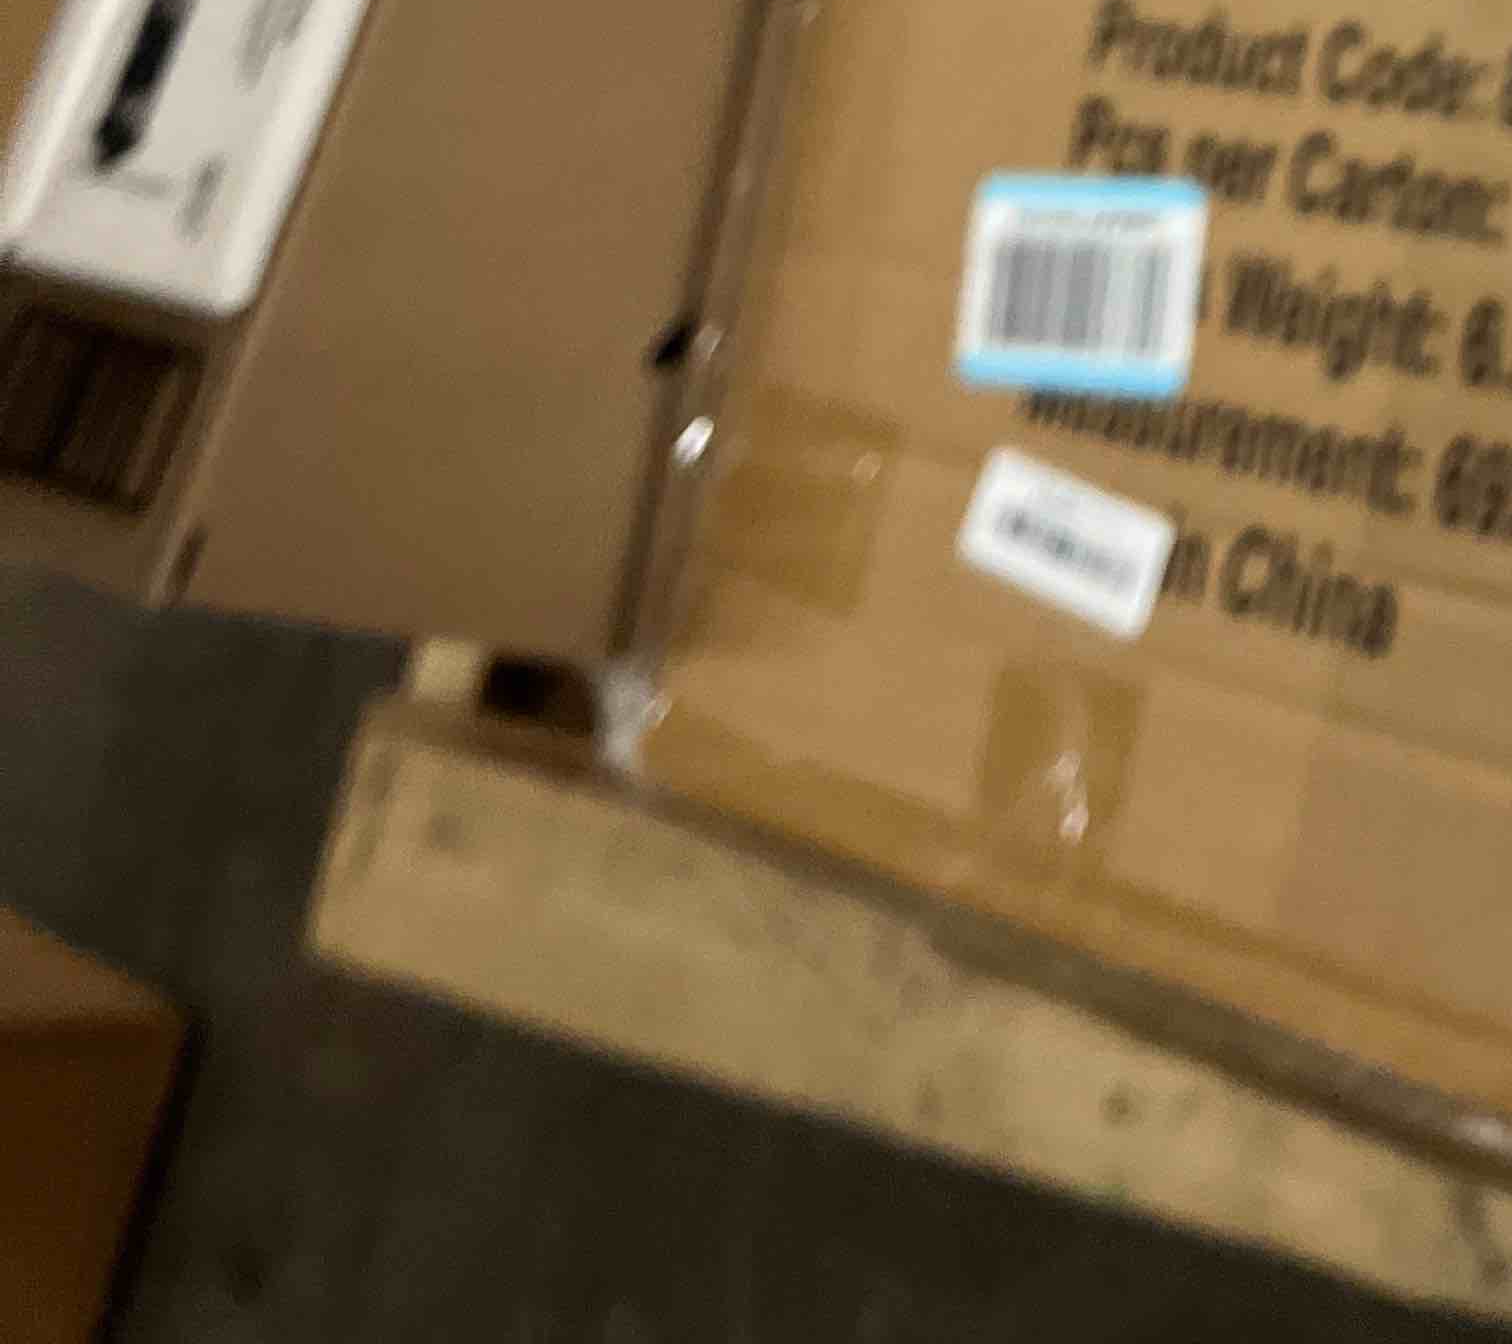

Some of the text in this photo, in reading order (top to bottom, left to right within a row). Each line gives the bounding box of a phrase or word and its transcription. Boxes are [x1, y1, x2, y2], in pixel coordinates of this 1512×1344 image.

[1315, 18, 1490, 119] Code:
[1289, 128, 1507, 248] Carton:
[1222, 251, 1442, 383] Weight:
[1219, 522, 1400, 661] China
